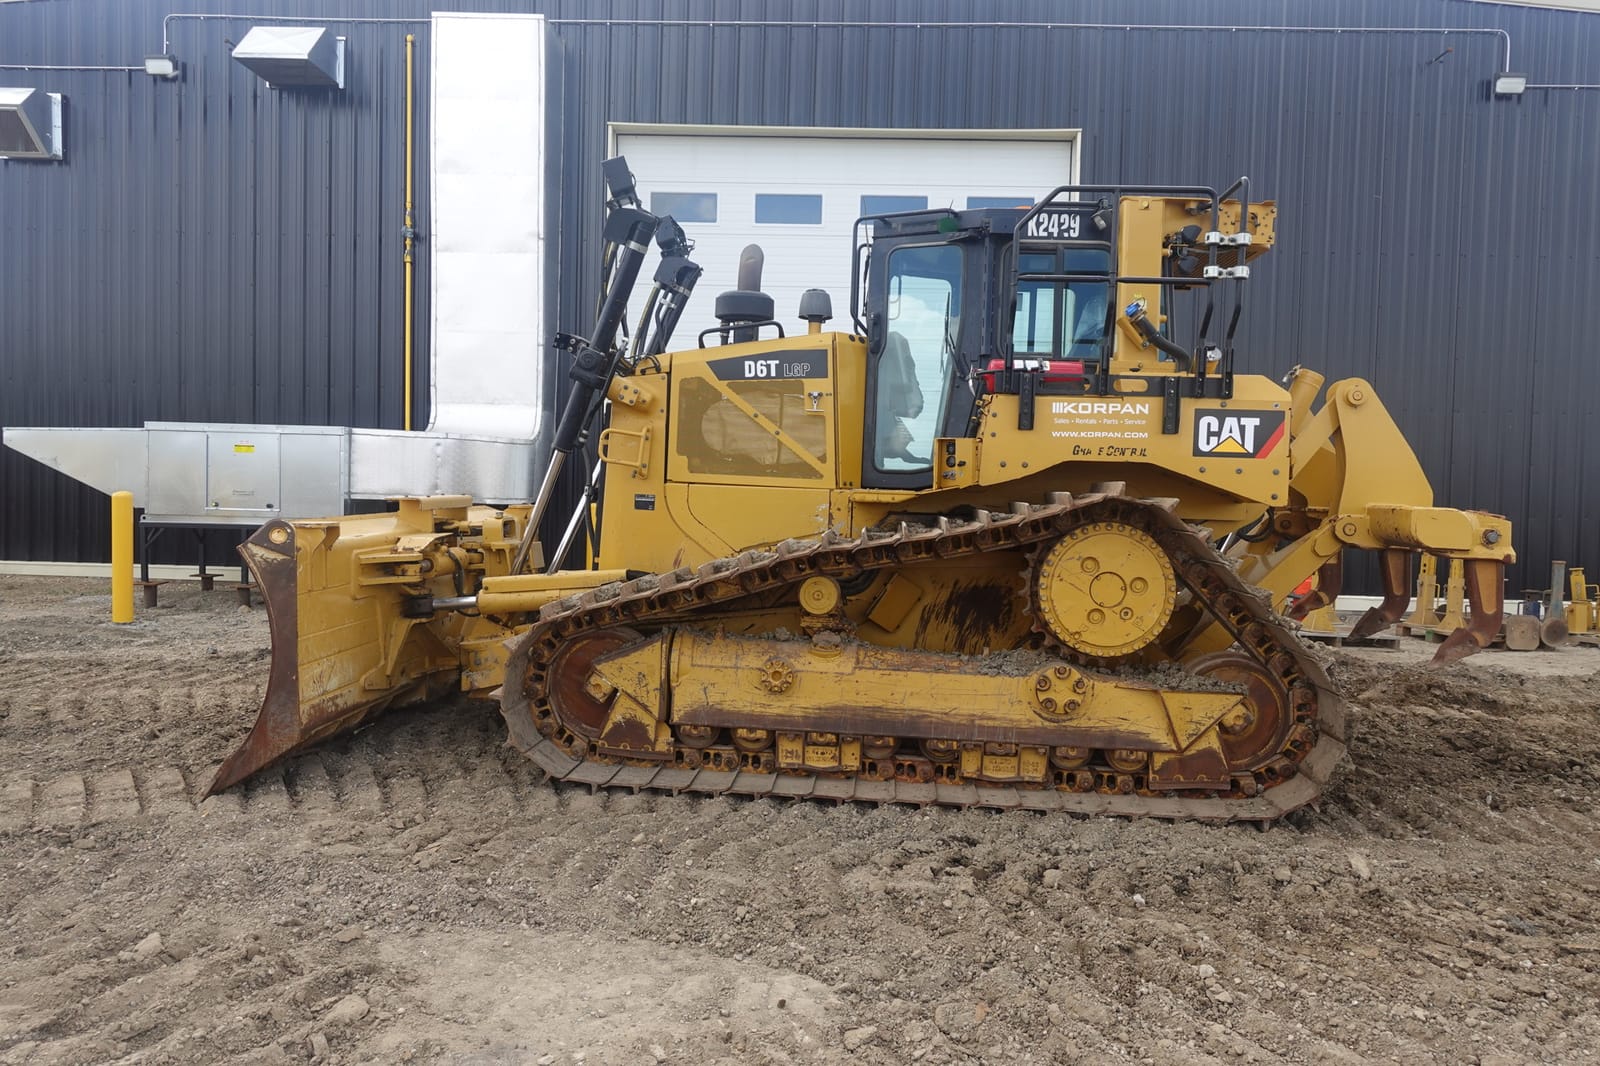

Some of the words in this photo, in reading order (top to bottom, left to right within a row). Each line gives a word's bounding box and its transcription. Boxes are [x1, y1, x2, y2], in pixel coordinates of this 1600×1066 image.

[744, 360, 779, 378] D6T
[783, 363, 811, 377] LGP
[1062, 401, 1149, 415] KORPAN
[1054, 417, 1070, 425] Sales
[1075, 417, 1097, 425] Rentals
[1103, 418, 1119, 426] Parts
[1124, 418, 1147, 426] Service
[1051, 431, 1149, 439] WWW.KORPAN.COM
[1198, 415, 1261, 454] CAT
